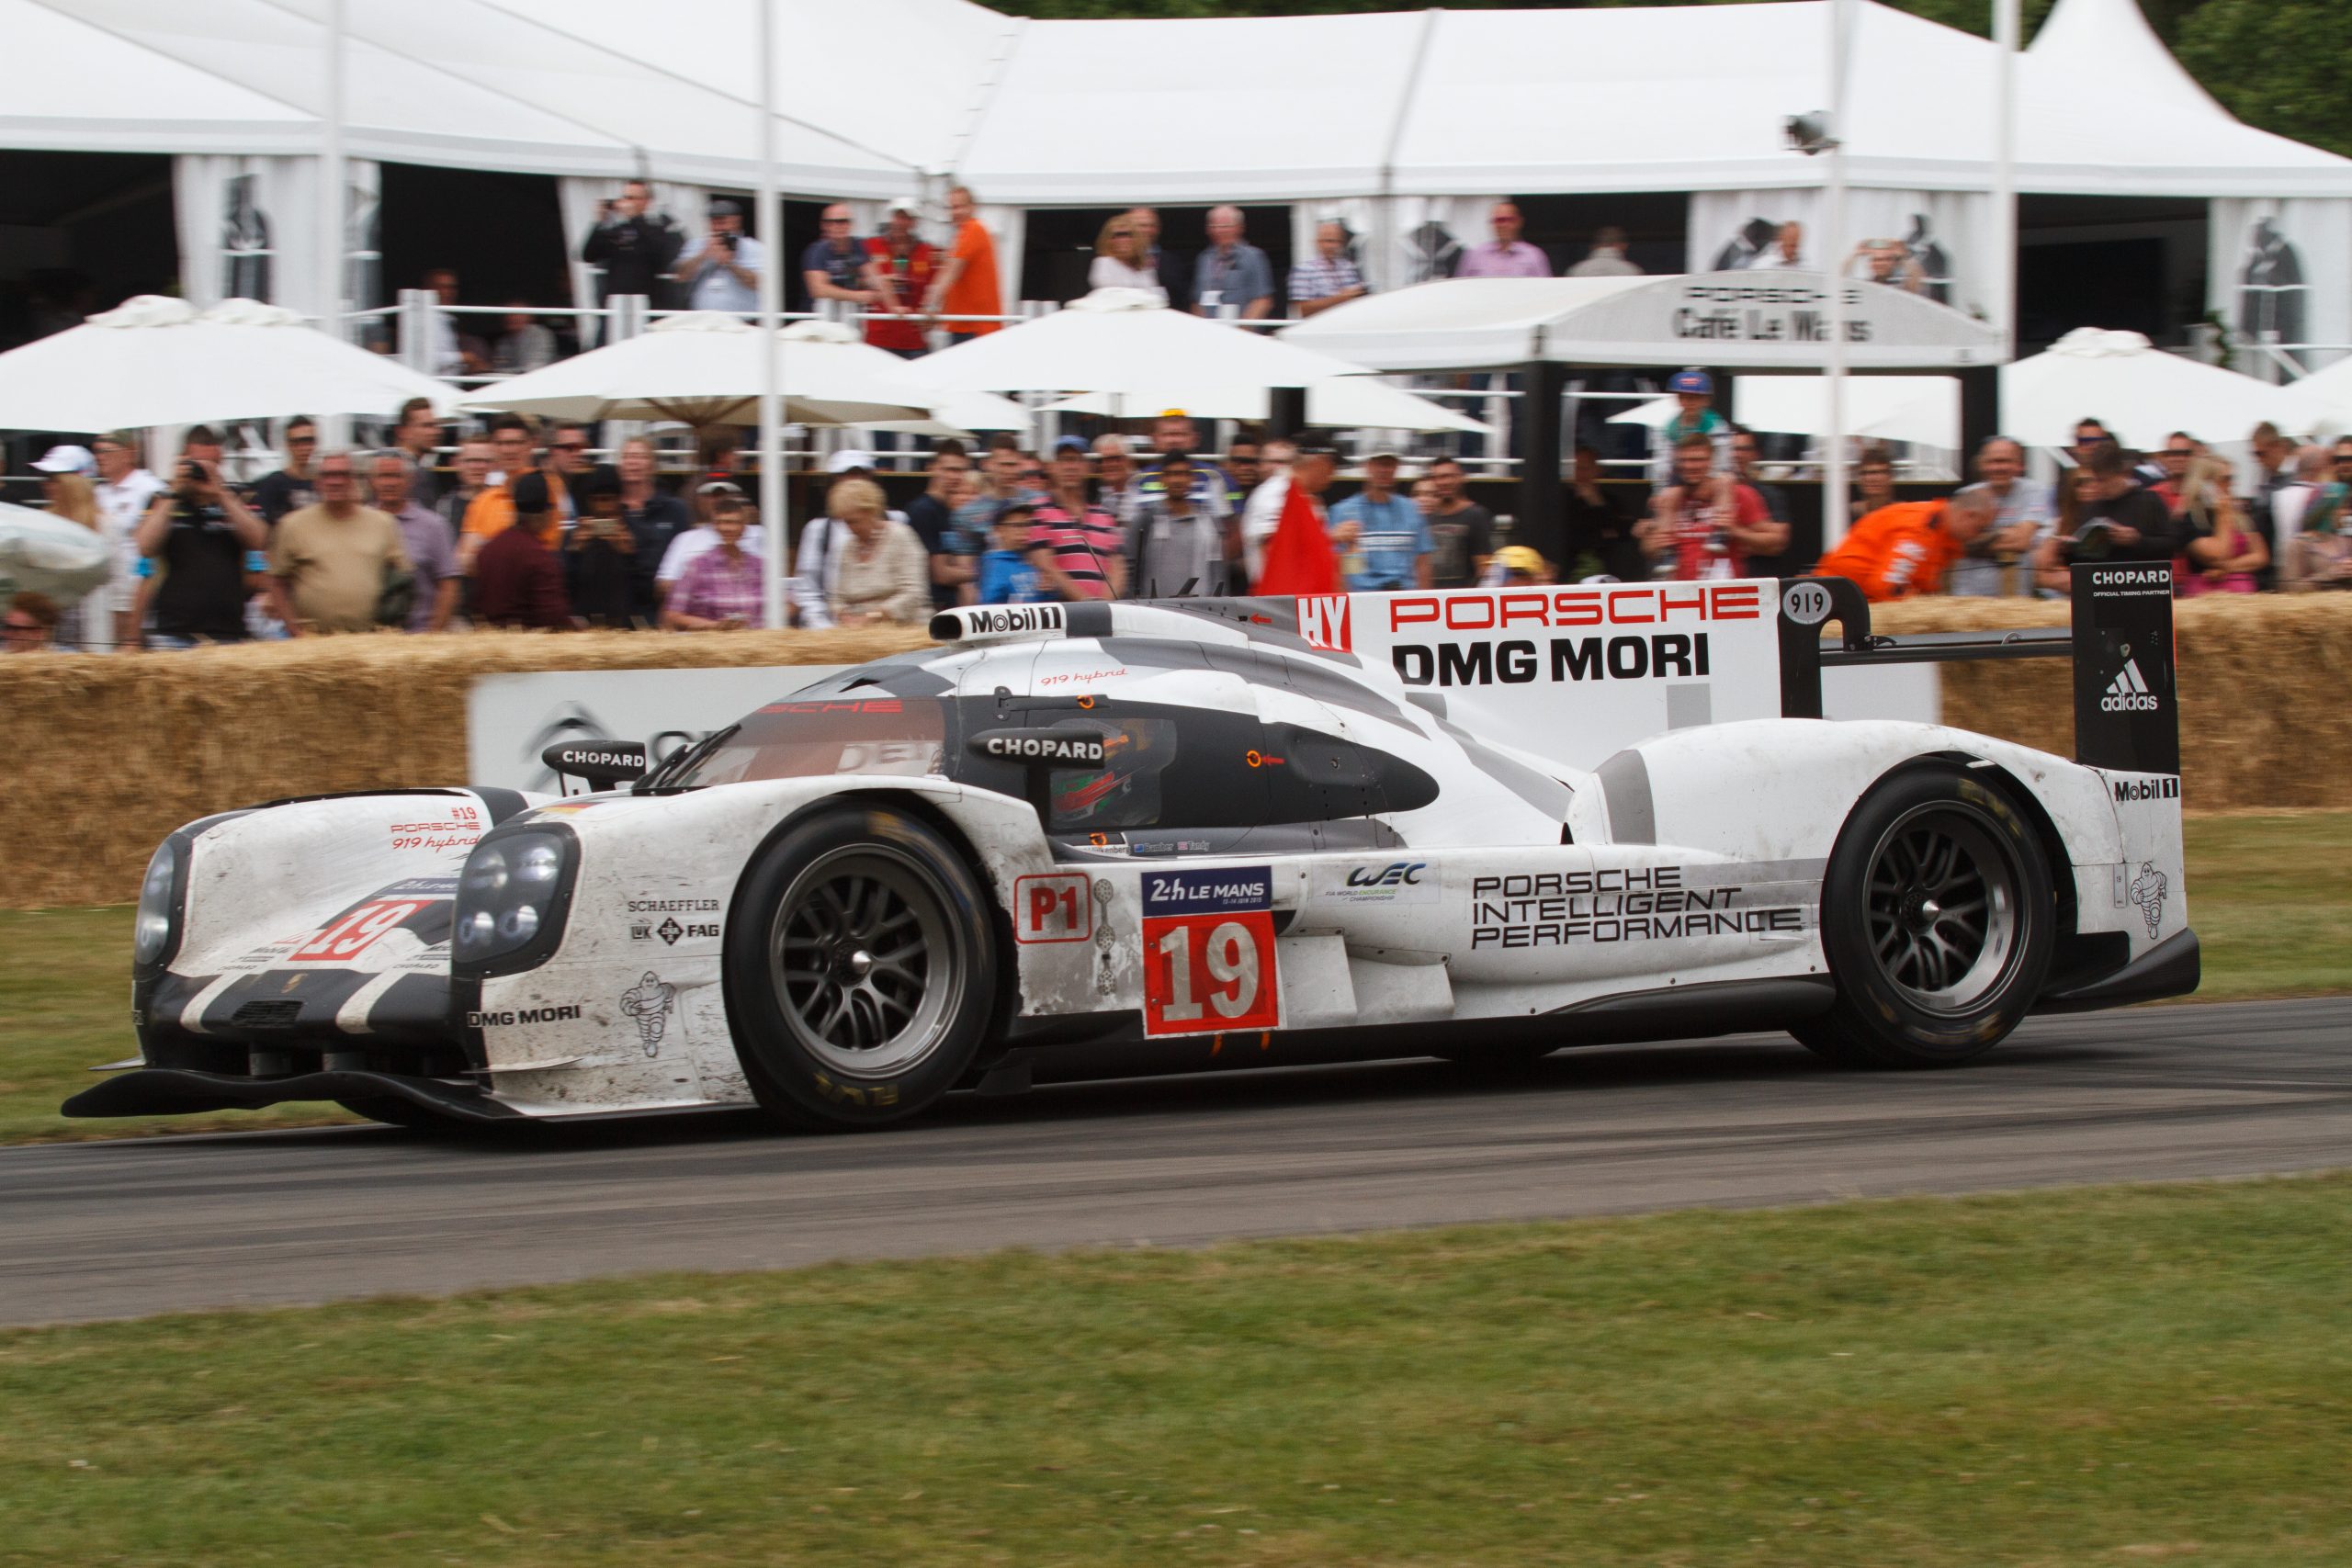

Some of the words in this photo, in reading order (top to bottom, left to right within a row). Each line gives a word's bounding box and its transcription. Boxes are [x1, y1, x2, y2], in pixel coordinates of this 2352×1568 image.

[1747, 309, 1782, 341] Le
[2092, 570, 2170, 584] CHOPARD
[1390, 585, 1759, 633] PORSCHE
[1791, 592, 1824, 614] 919
[968, 607, 1036, 633] Mobil
[1297, 595, 1349, 650] HY
[1392, 640, 1537, 687] DMG
[1550, 632, 1710, 682] MORI
[1040, 674, 1069, 686] 919
[1073, 667, 1129, 685] hybrid
[2100, 693, 2159, 712] adidas
[561, 750, 646, 768] CHOPARD
[987, 738, 1102, 760] CHOPARD
[2115, 779, 2159, 802] Mobil
[451, 807, 477, 819] #19
[390, 822, 481, 833] PORSCHE
[392, 837, 422, 850] 919
[424, 834, 481, 853] hybrid
[1346, 862, 1426, 886] WEC
[1473, 866, 1681, 899] PORSCHE
[1150, 878, 1185, 901] 24h
[1188, 886, 1211, 899] LE
[1213, 883, 1264, 898] MANS
[628, 899, 720, 912] SCHAEFFLER
[1029, 886, 1078, 931] P1
[1473, 887, 1742, 924] INTELLIGENT
[299, 903, 418, 955] 19
[687, 924, 719, 937] FAG
[1471, 908, 1804, 950] PERFORMANCE
[1159, 922, 1259, 1021] 19
[467, 1011, 514, 1028] DMG
[519, 1005, 581, 1024] MORI
